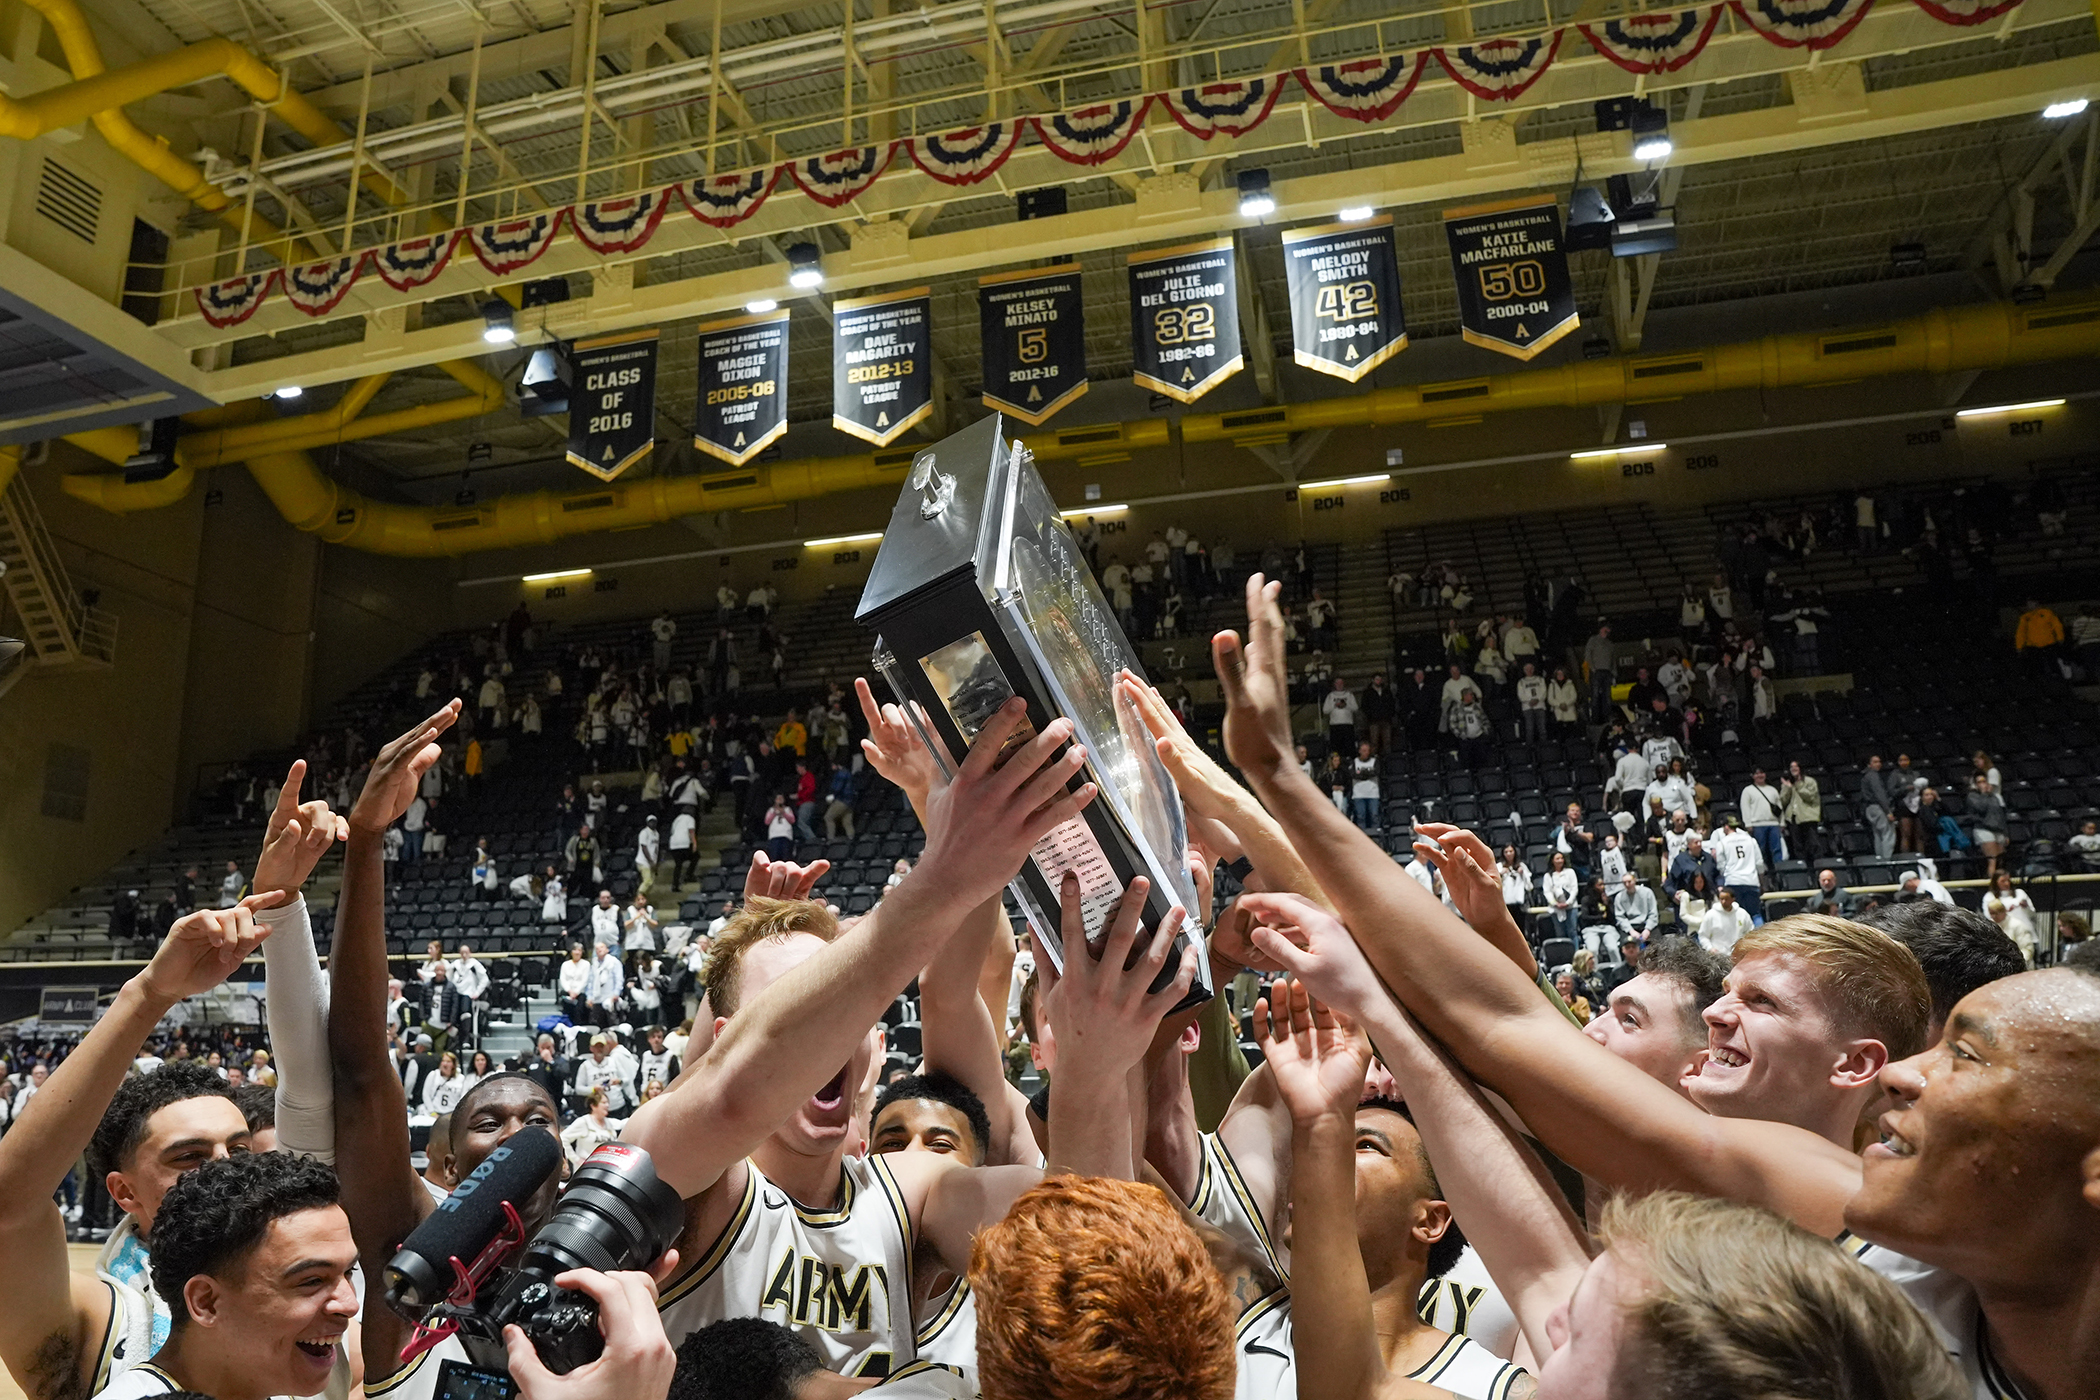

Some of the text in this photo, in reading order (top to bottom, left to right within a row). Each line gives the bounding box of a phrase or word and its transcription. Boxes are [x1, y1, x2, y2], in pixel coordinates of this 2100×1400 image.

[1456, 215, 1552, 236] WOMEN'S BASKETBALL
[1293, 236, 1387, 258] WOMEN'S BASKETBALL
[1482, 231, 1529, 248] KATIE
[1311, 250, 1370, 271] MELODY
[1460, 240, 1556, 264] MACFARLANE
[1136, 258, 1226, 279] WOMEN'S BASKETBALL
[1317, 264, 1368, 282] SMITH
[1163, 274, 1202, 292] JULIE
[1479, 260, 1546, 301] 50
[989, 284, 1071, 302] WOMEN'S BASKETBALL
[1141, 283, 1225, 307] DEL GIORNO
[1315, 280, 1379, 322] 42
[1006, 298, 1055, 315] KELSEY
[1486, 301, 1549, 320] 2000-04
[840, 307, 922, 327] WOMEN'S BASKETBALL
[840, 315, 922, 336] COACH OF THE YEAR
[1005, 310, 1058, 327] MINATO
[1155, 302, 1216, 345] 32
[704, 329, 781, 348] WOMEN'S BASKETBALL
[1319, 321, 1379, 343] 1980-84
[1515, 322, 1530, 339] A
[704, 337, 781, 358] COACH OF THE YEAR
[864, 333, 897, 349] DAVE
[1018, 328, 1047, 363] 5
[581, 348, 649, 366] WOMEN'S BASKETBALL
[845, 342, 916, 364] MAGARITY
[1158, 343, 1215, 363] 1982-86
[1344, 343, 1360, 361] A
[717, 353, 766, 372] MAGGIE
[586, 367, 641, 391] CLASS
[722, 366, 761, 382] DIXON
[847, 360, 914, 384] 2012-13
[1009, 365, 1059, 383] 2012-16
[1181, 366, 1195, 383] A
[707, 380, 775, 405] 2005-06
[860, 381, 901, 396] PATRIOT
[863, 391, 899, 404] LEAGUE
[1027, 384, 1043, 402] A
[601, 391, 624, 410] OF
[721, 401, 759, 416] PATRIOT
[589, 412, 633, 434] 2016
[724, 411, 756, 425] LEAGUE
[876, 411, 889, 427] A
[2009, 420, 2044, 436] 207
[734, 431, 746, 447] A
[1622, 463, 1655, 477] 205
[1314, 496, 1344, 510] 204
[546, 587, 566, 598] 201
[1736, 846, 1746, 859] 6
[441, 1095, 448, 1106] 6
